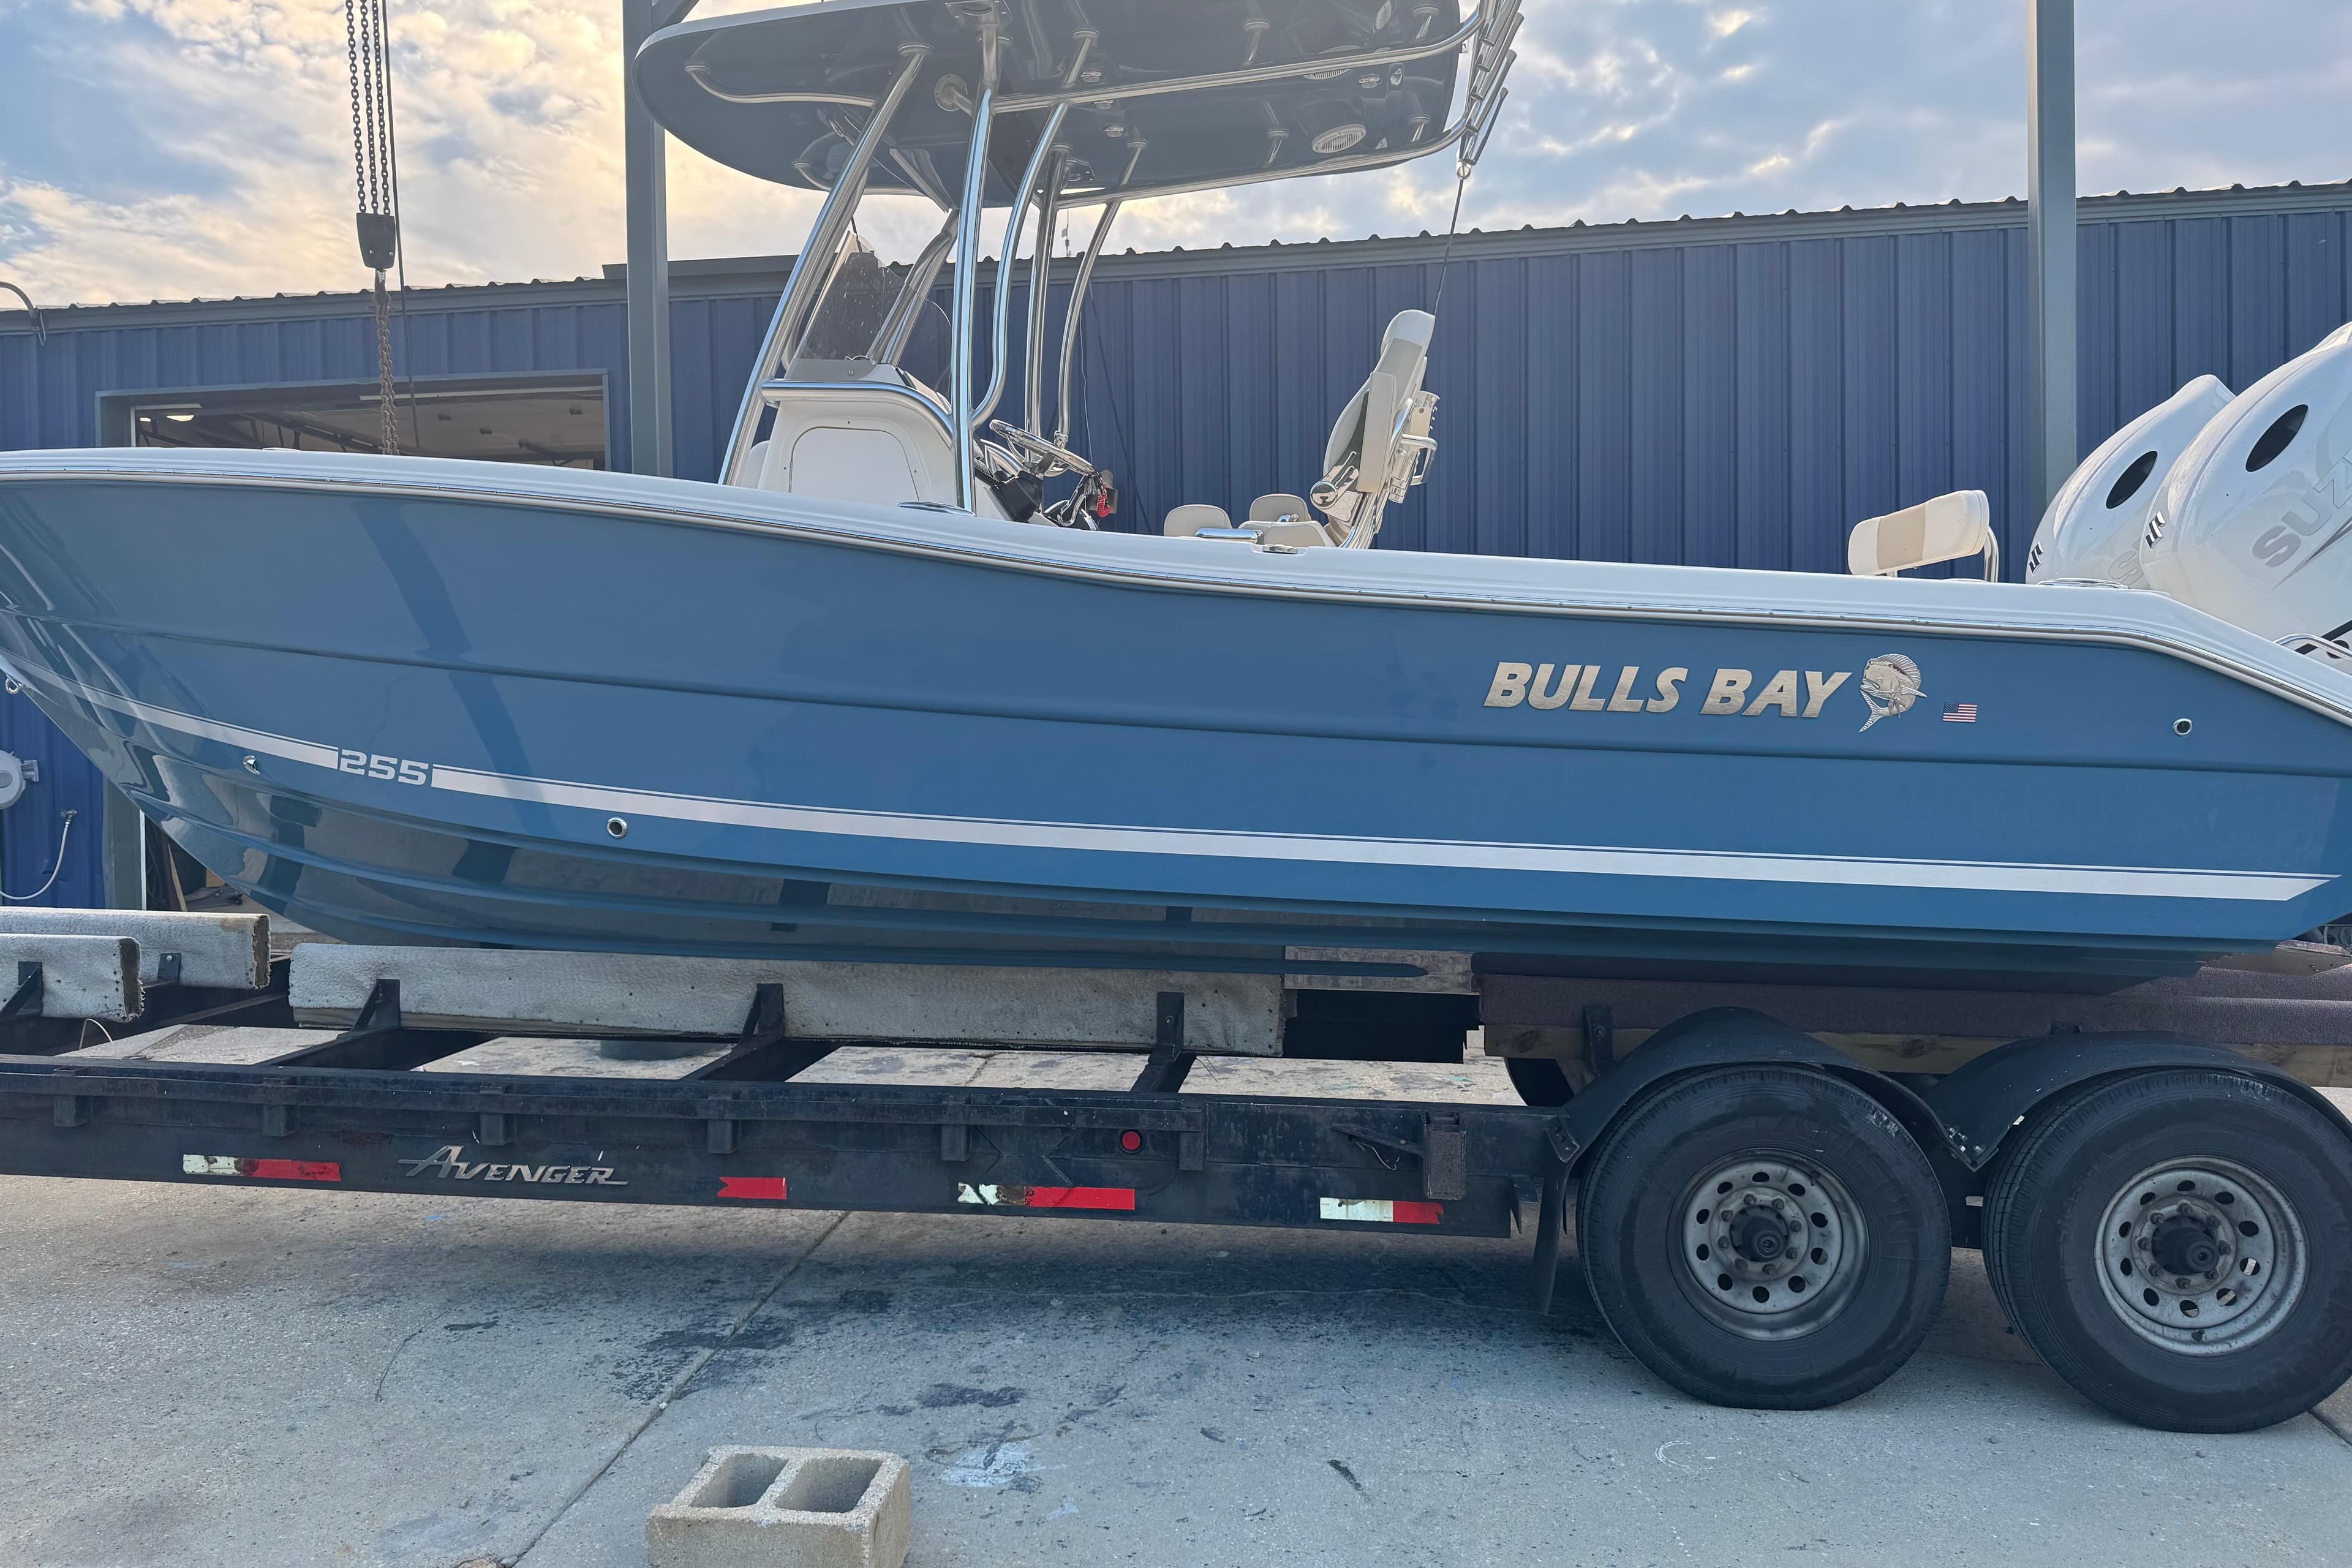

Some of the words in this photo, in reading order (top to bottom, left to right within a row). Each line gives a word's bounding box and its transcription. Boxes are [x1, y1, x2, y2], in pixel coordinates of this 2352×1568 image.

[2252, 448, 2352, 568] SUZ
[1483, 662, 1689, 713] BULLS
[1700, 668, 1852, 718] BAY
[339, 748, 429, 785] 255
[398, 1145, 629, 1185] AVENGER
